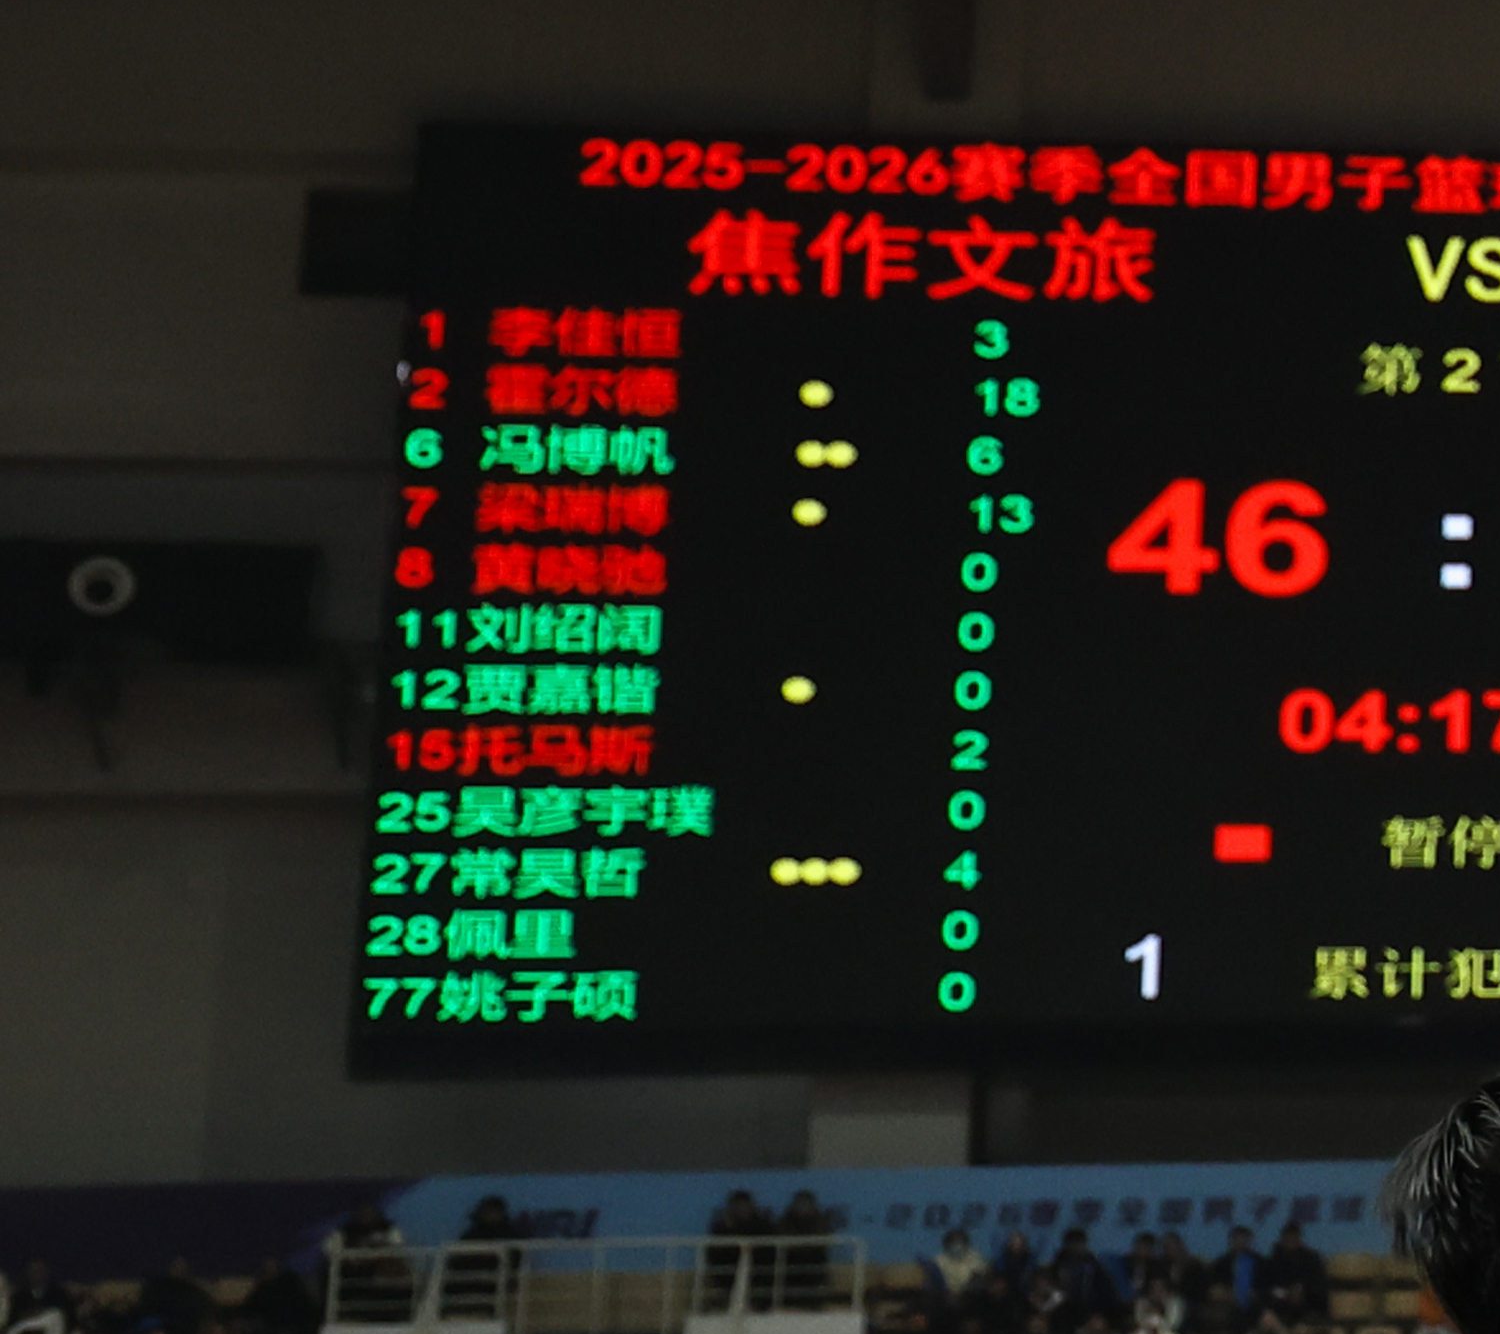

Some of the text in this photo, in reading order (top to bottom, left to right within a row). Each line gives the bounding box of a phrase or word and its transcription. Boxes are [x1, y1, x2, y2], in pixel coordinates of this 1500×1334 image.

[688, 212, 1155, 302] 焦作文旅
[422, 311, 444, 347] 1
[974, 321, 1009, 359] 3
[405, 368, 447, 409] 2
[977, 378, 1039, 414] 18
[405, 425, 1002, 475] 6 冯博帆 6
[404, 487, 438, 526] 7
[970, 495, 1033, 533] 13
[1107, 478, 1329, 598] 46
[395, 547, 433, 588] 8
[961, 553, 997, 591] 0
[958, 612, 994, 651] 0
[955, 671, 991, 710] 0
[951, 730, 988, 770] 2
[949, 790, 985, 830] 0
[944, 851, 980, 889] 4
[942, 910, 979, 950] 0
[1125, 934, 1161, 999] 1
[938, 972, 975, 1011] 0
